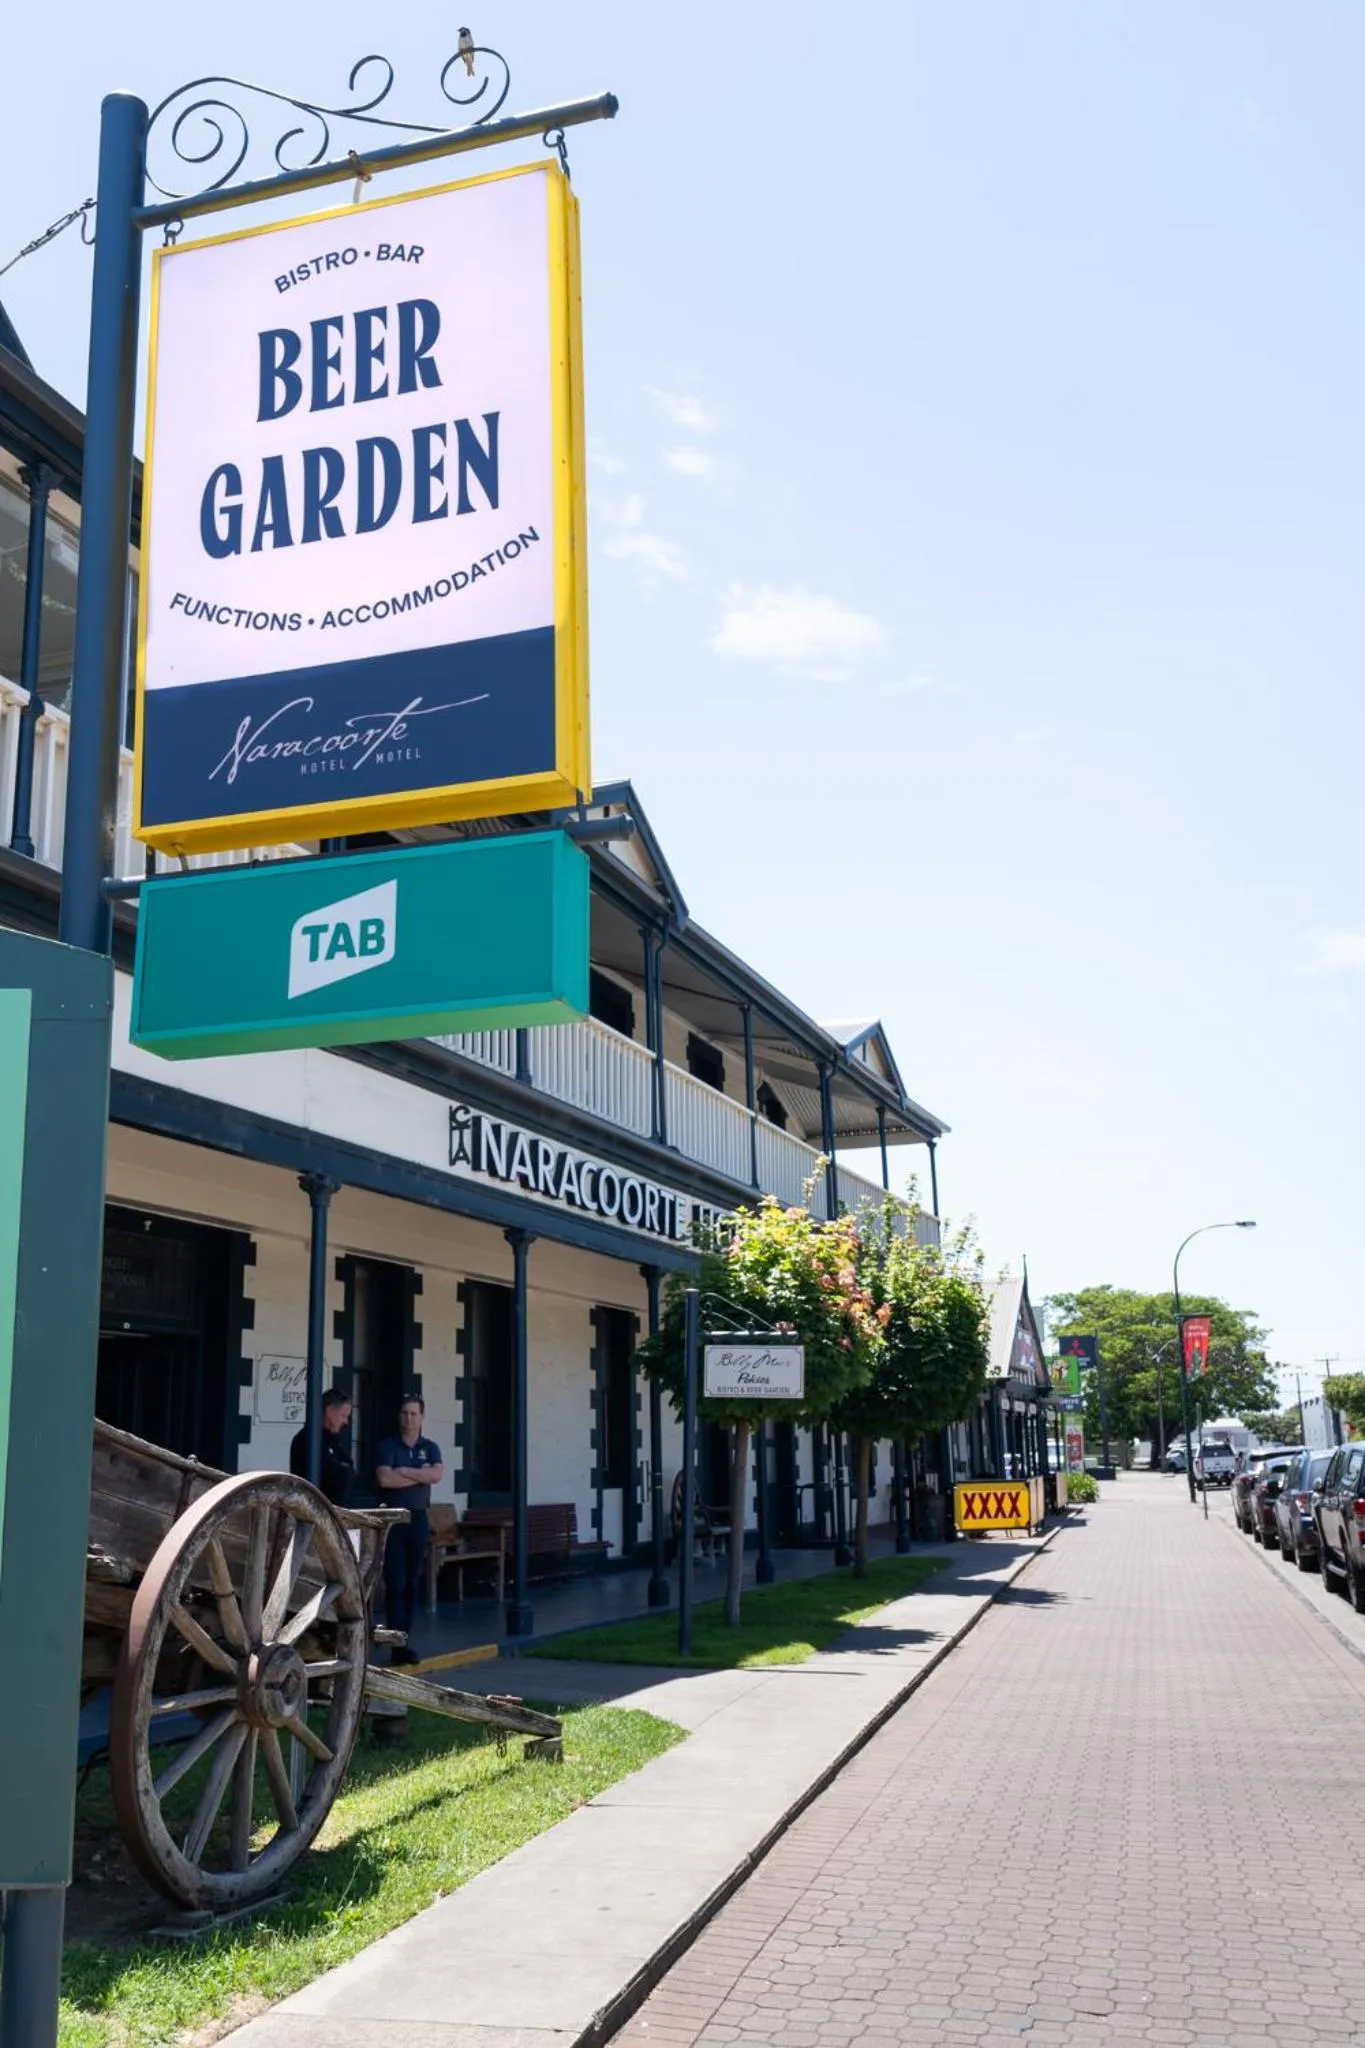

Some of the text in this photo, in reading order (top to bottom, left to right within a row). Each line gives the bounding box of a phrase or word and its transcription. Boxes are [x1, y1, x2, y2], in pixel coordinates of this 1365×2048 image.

[274, 243, 424, 294] BISTRO BAR
[256, 298, 443, 423] BEER
[200, 411, 500, 559] GARDEN
[169, 525, 541, 632] FUNCTIONS ACCOMMODATION
[208, 693, 490, 784] Naracoorte
[300, 748, 422, 775] HOTEL MOTEL
[302, 918, 386, 962] TAB
[474, 1115, 687, 1240] NARACOORTE
[962, 1491, 1021, 1520] XXXX
